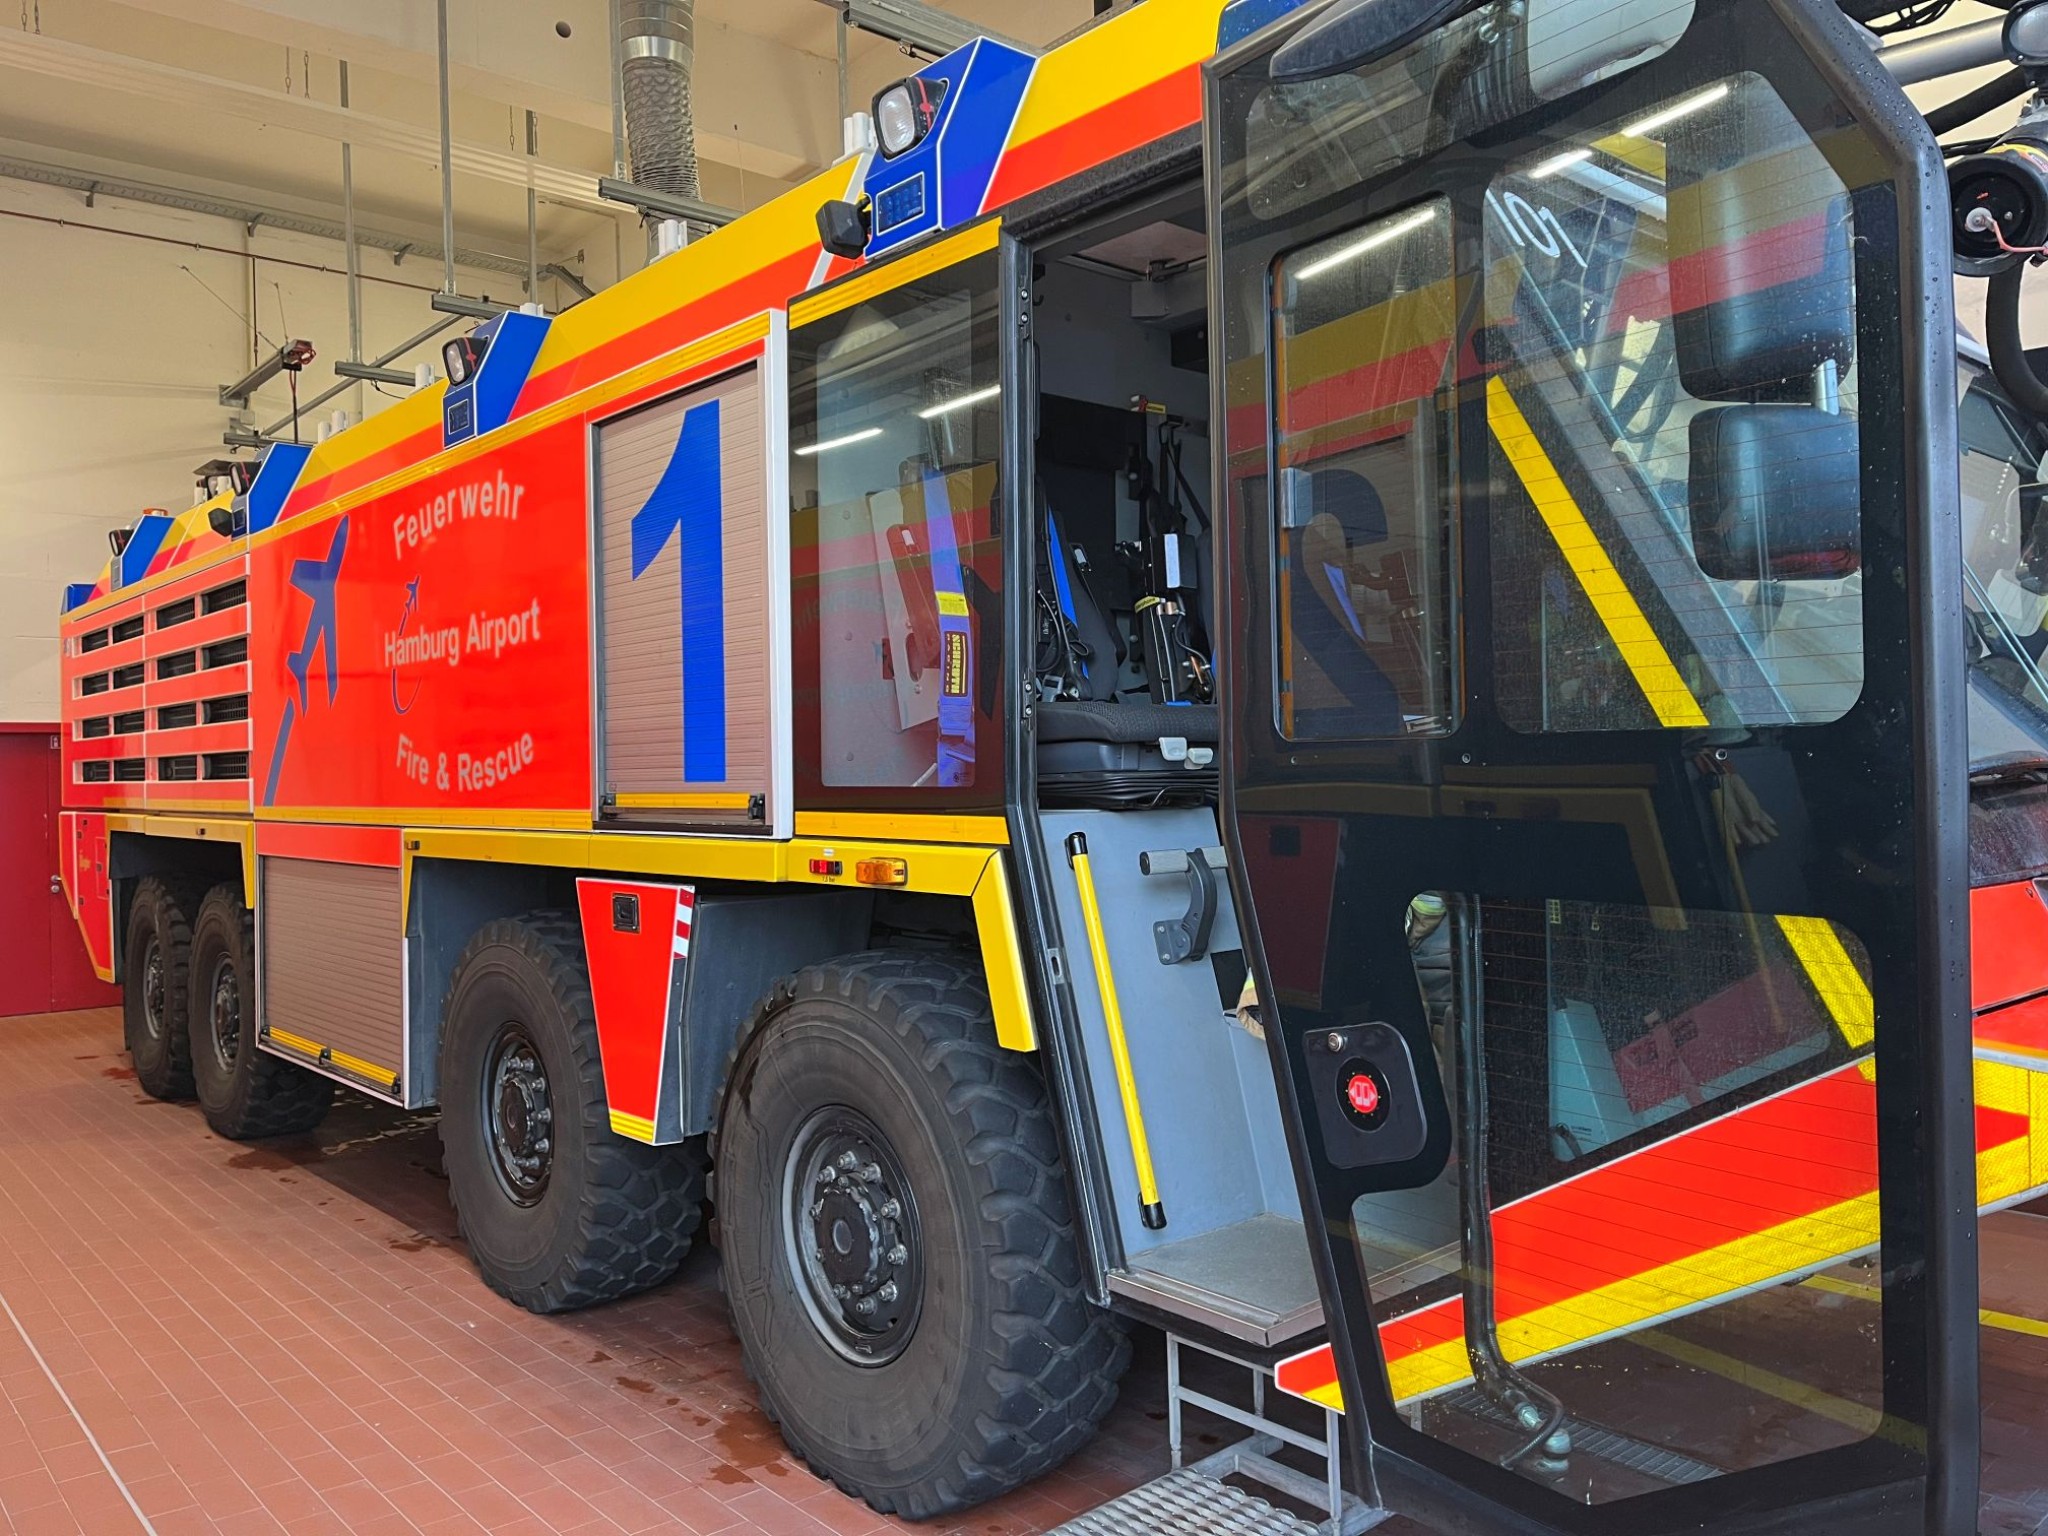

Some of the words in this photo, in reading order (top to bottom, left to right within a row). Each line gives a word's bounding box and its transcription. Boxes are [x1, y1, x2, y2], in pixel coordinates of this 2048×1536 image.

[393, 468, 525, 561] Feuerwehr
[631, 398, 727, 783] 1
[384, 624, 460, 667] Hamburg
[466, 597, 541, 659] Airport
[396, 733, 430, 786] Fire
[436, 752, 450, 792] &
[457, 732, 534, 793] Rescue
